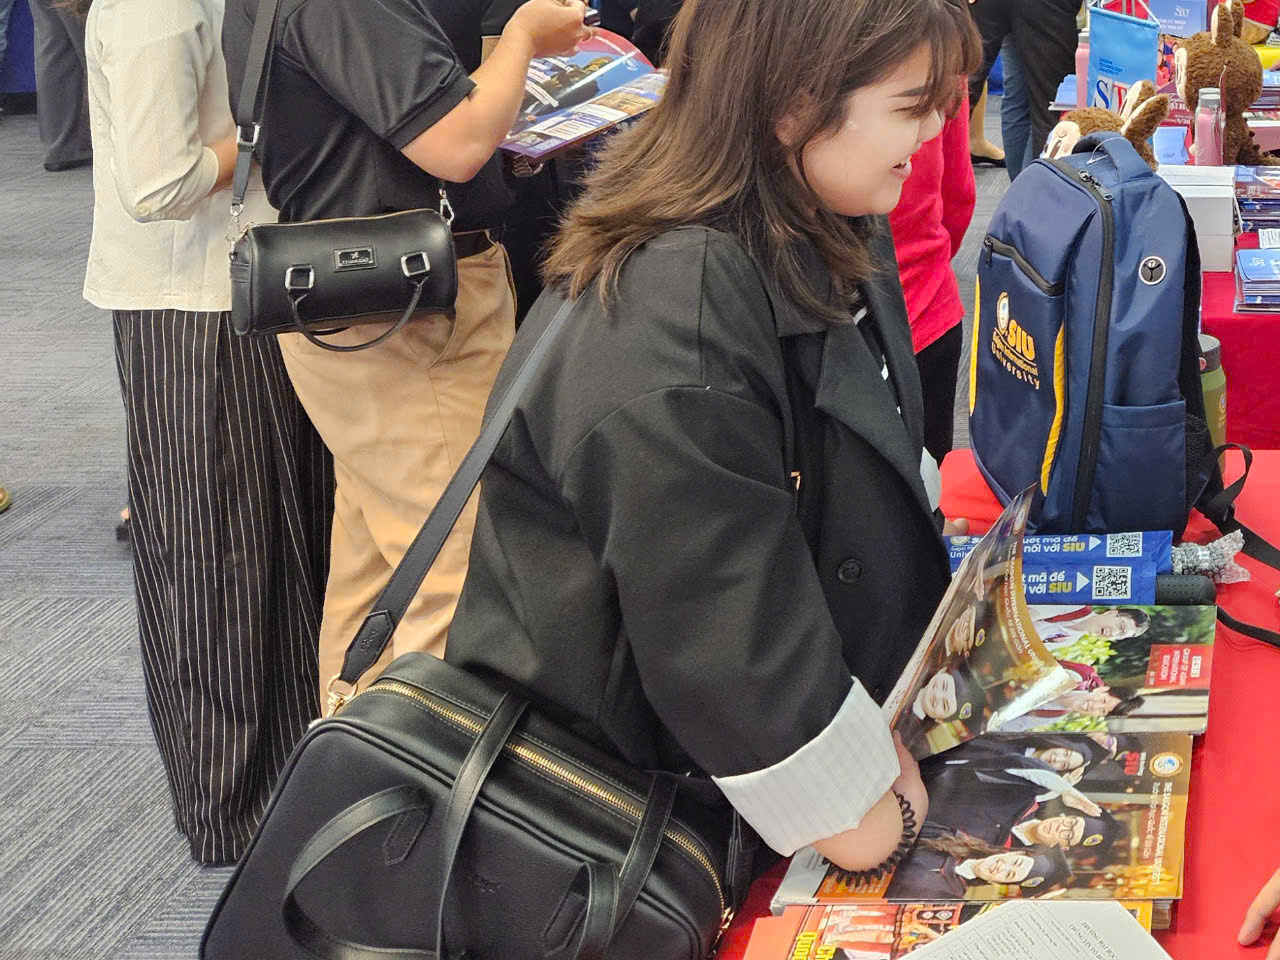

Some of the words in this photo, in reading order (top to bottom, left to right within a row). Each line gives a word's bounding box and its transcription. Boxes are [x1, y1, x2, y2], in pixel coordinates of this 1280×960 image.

[1093, 79, 1128, 113] ST
[1007, 319, 1036, 361] SIU
[991, 341, 1040, 390] University
[1062, 541, 1086, 553] SIU
[1027, 571, 1047, 583] mã
[1048, 581, 1073, 593] SIU
[1124, 750, 1139, 776] SIU
